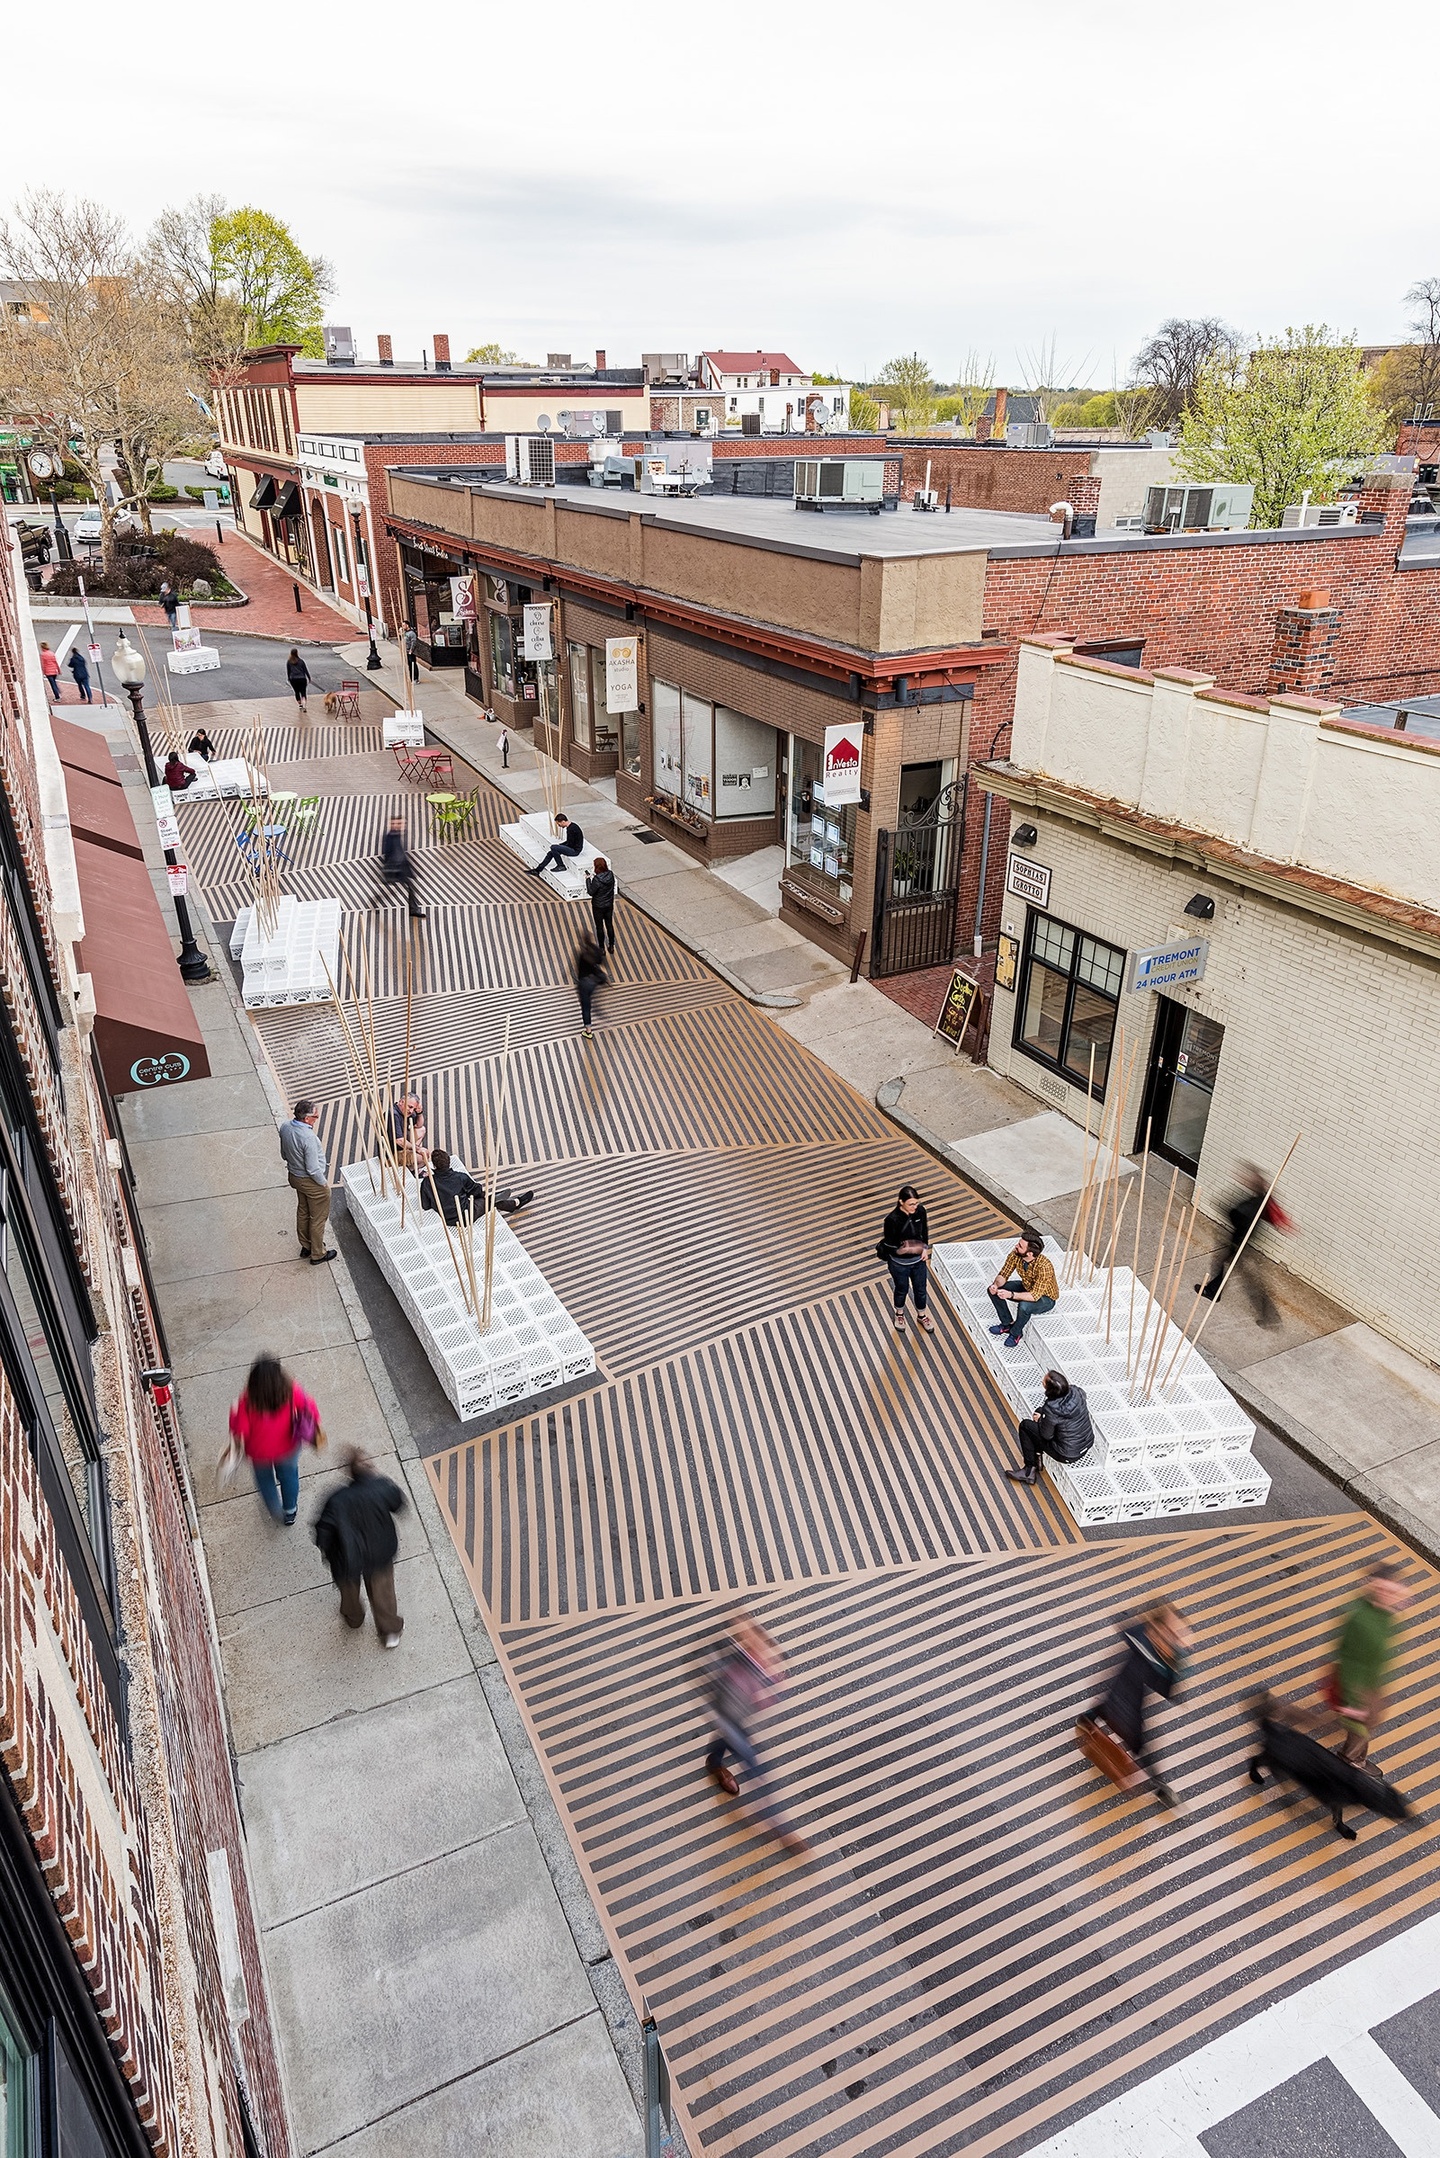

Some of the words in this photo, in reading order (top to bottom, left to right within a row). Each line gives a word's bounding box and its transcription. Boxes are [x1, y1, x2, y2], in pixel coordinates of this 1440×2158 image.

[608, 659, 636, 667] AKASHA
[610, 683, 633, 691] YOGA
[826, 769, 859, 778] Realty
[1015, 863, 1044, 882] SOPHIAS
[1015, 880, 1041, 897] GROTTO
[1152, 947, 1201, 966] TREMONT
[1150, 962, 1176, 973] CREDIT
[1176, 957, 1199, 968] UNION
[1135, 979, 1148, 990] 24
[1149, 973, 1177, 986] HOUR
[1178, 968, 1198, 980] ATM
